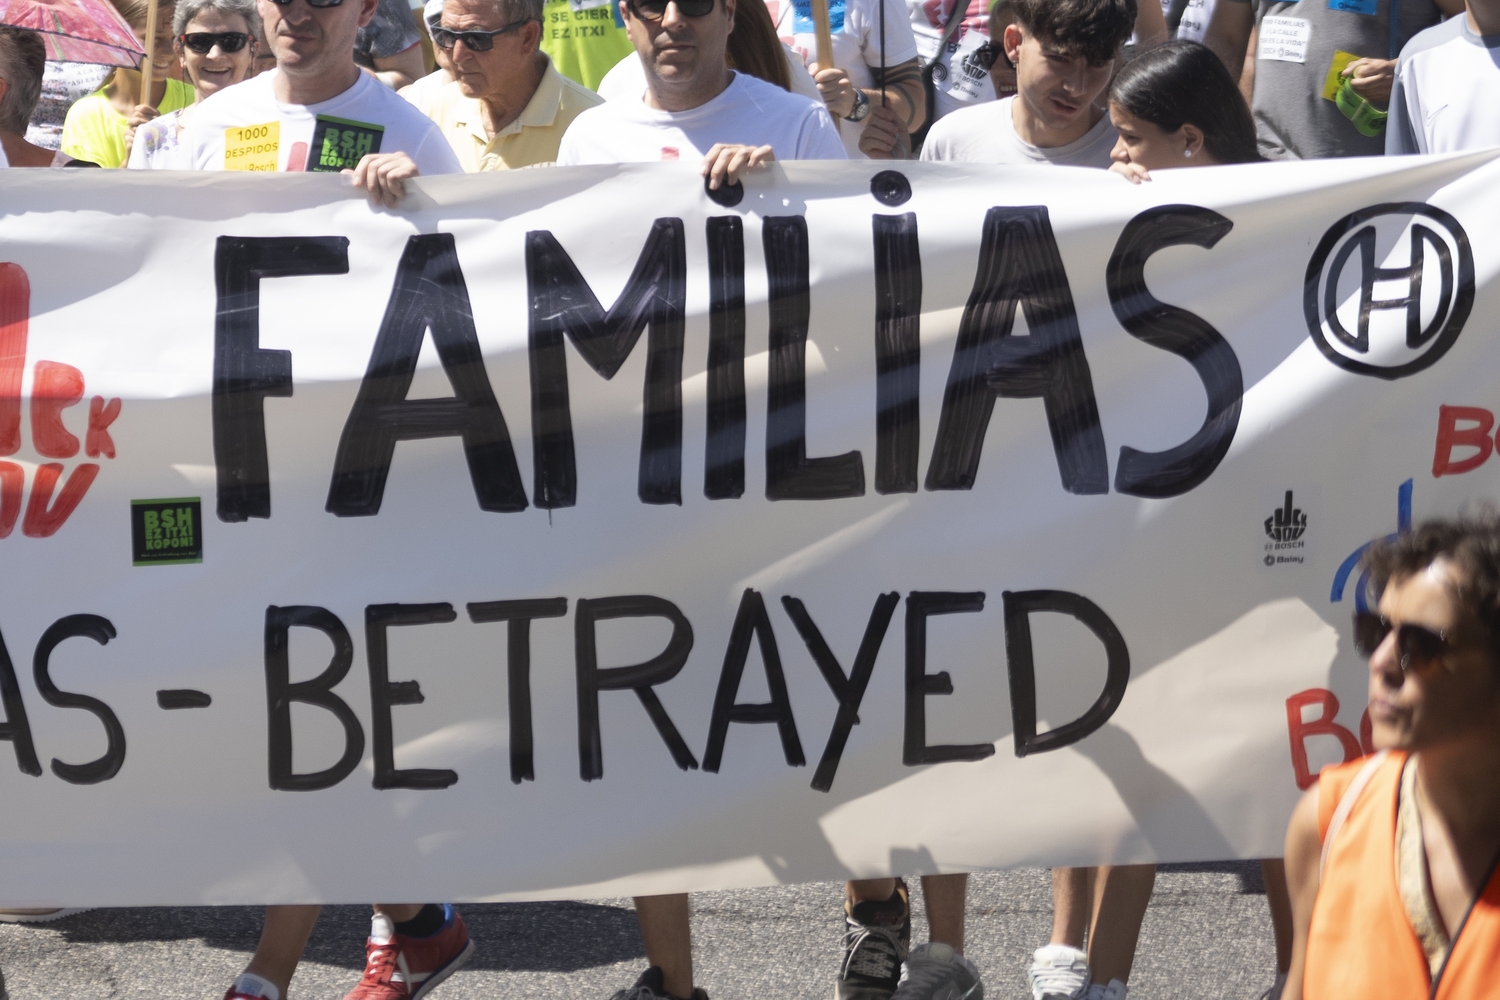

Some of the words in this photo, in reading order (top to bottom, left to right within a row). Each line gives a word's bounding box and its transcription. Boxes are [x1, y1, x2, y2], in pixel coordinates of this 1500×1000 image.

[551, 11, 569, 23] SE
[552, 28, 570, 40] EZ
[575, 26, 605, 38] ITXI
[237, 126, 268, 141] 1000
[323, 128, 373, 152] BSH
[225, 142, 278, 159] DESPIDOS
[144, 507, 192, 529] BSH
[145, 528, 162, 540] EZ
[164, 526, 194, 539] ITXI
[264, 587, 1130, 792] BETRAYED
